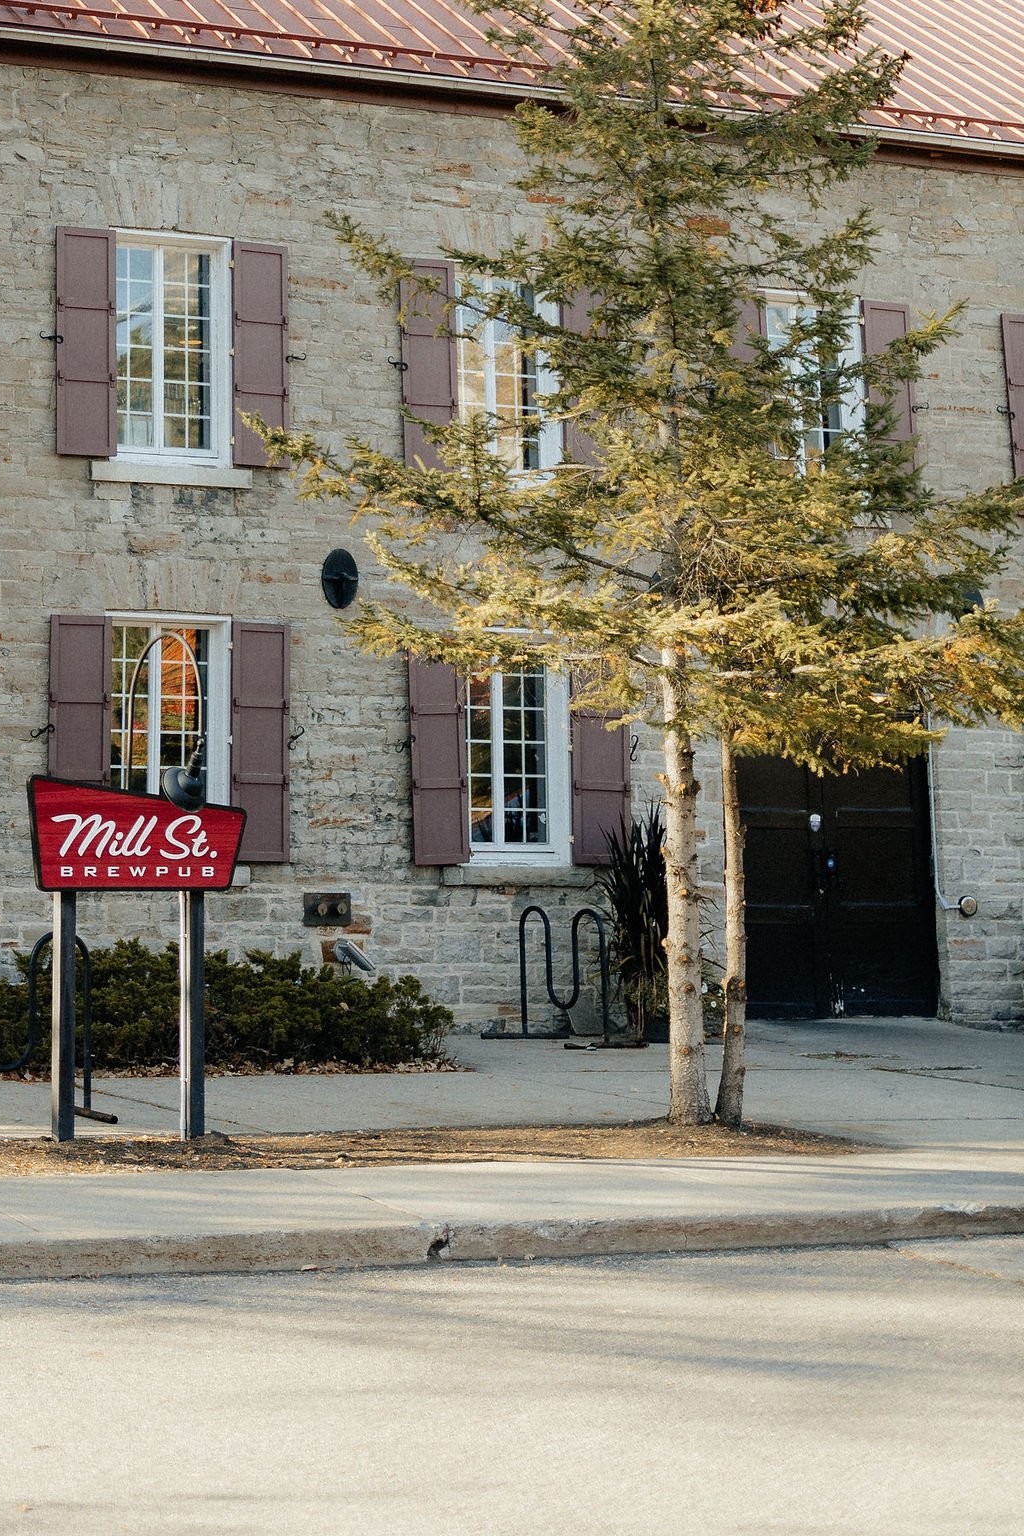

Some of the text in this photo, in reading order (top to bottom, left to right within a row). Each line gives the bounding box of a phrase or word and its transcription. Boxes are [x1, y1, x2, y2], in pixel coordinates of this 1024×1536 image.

[51, 814, 218, 860] Mill St.
[60, 866, 215, 877] BREWPUB
